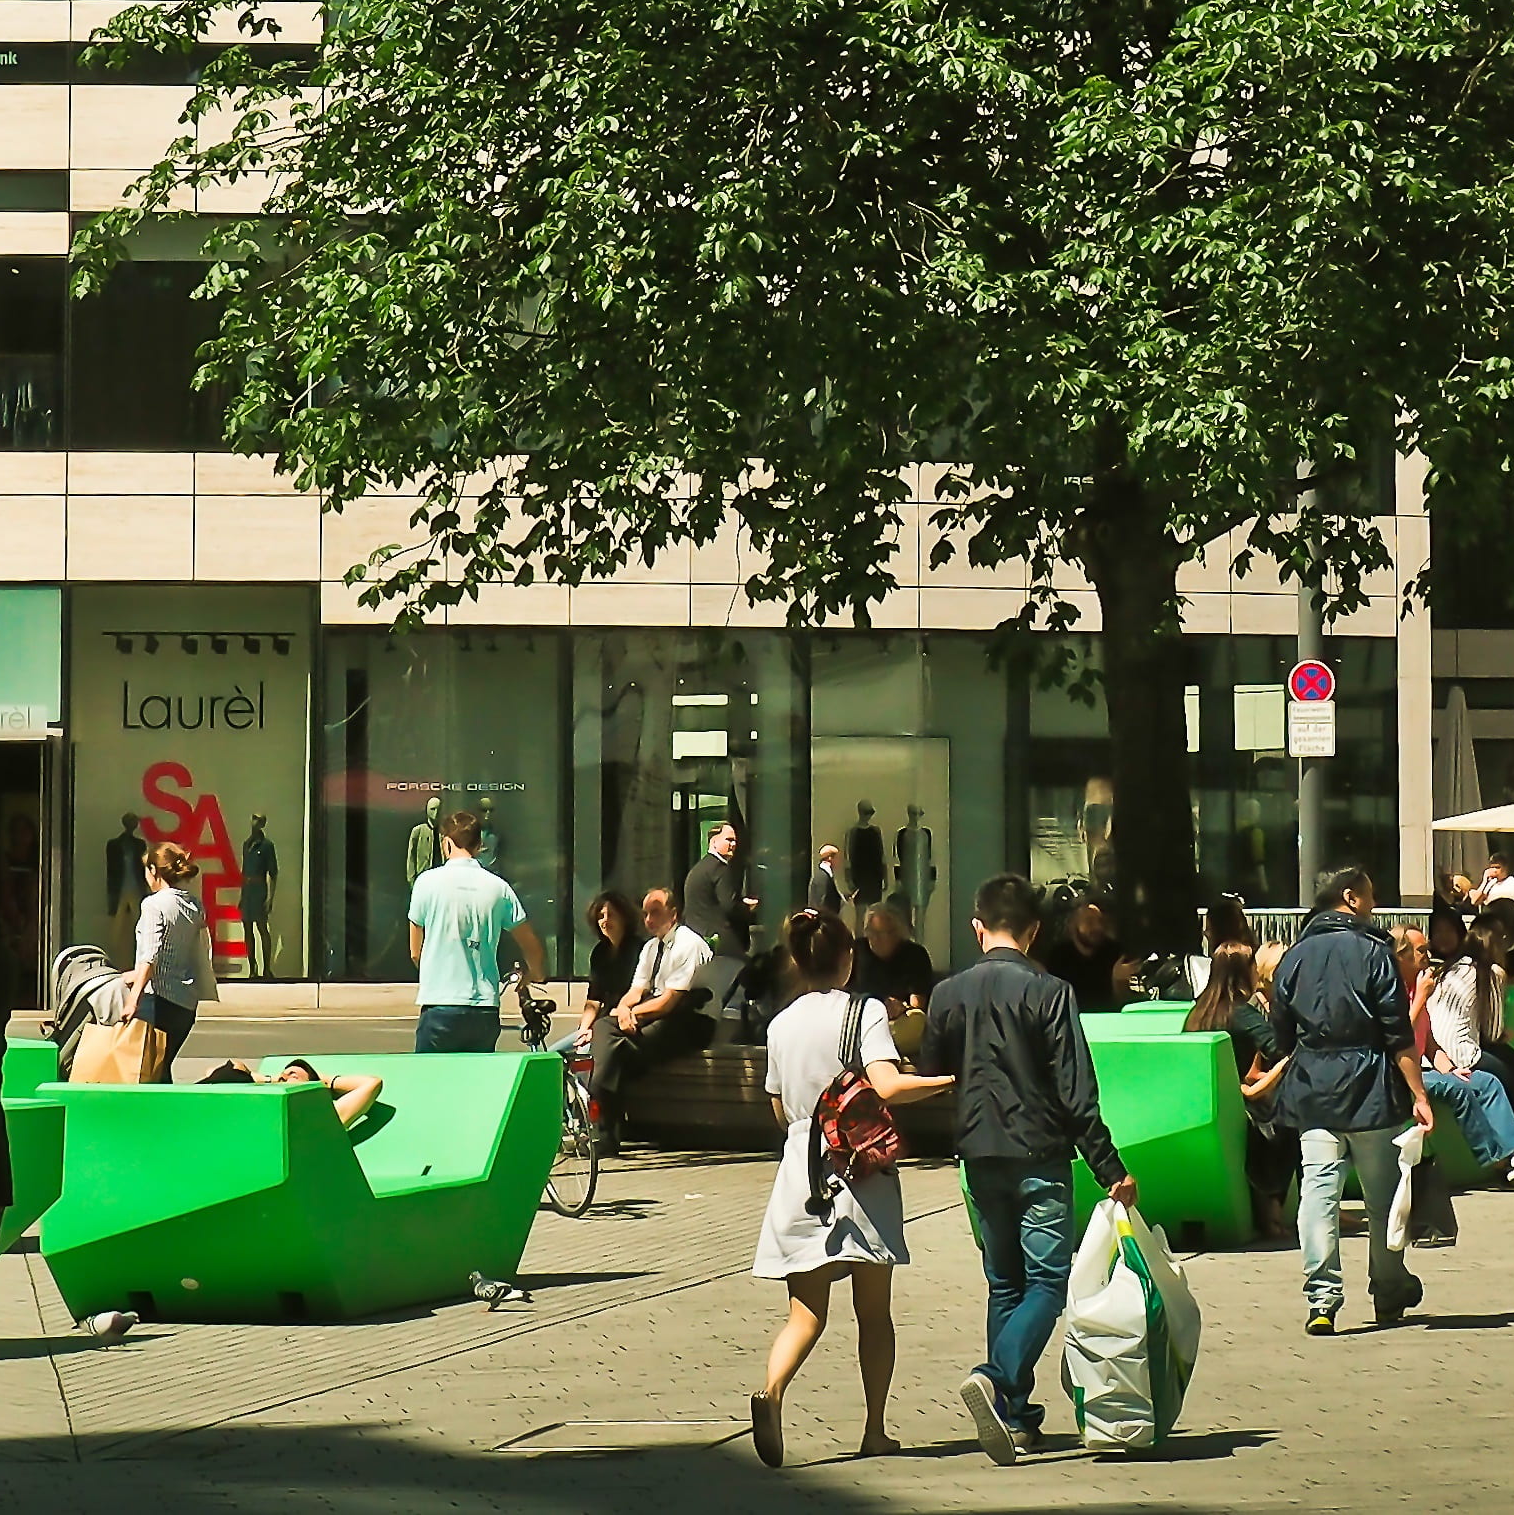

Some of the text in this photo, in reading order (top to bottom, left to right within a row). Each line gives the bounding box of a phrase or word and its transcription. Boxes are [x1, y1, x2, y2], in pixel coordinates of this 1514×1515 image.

[122, 680, 264, 730] Laurèl
[386, 782, 526, 792] PORSCHE DESIGN
